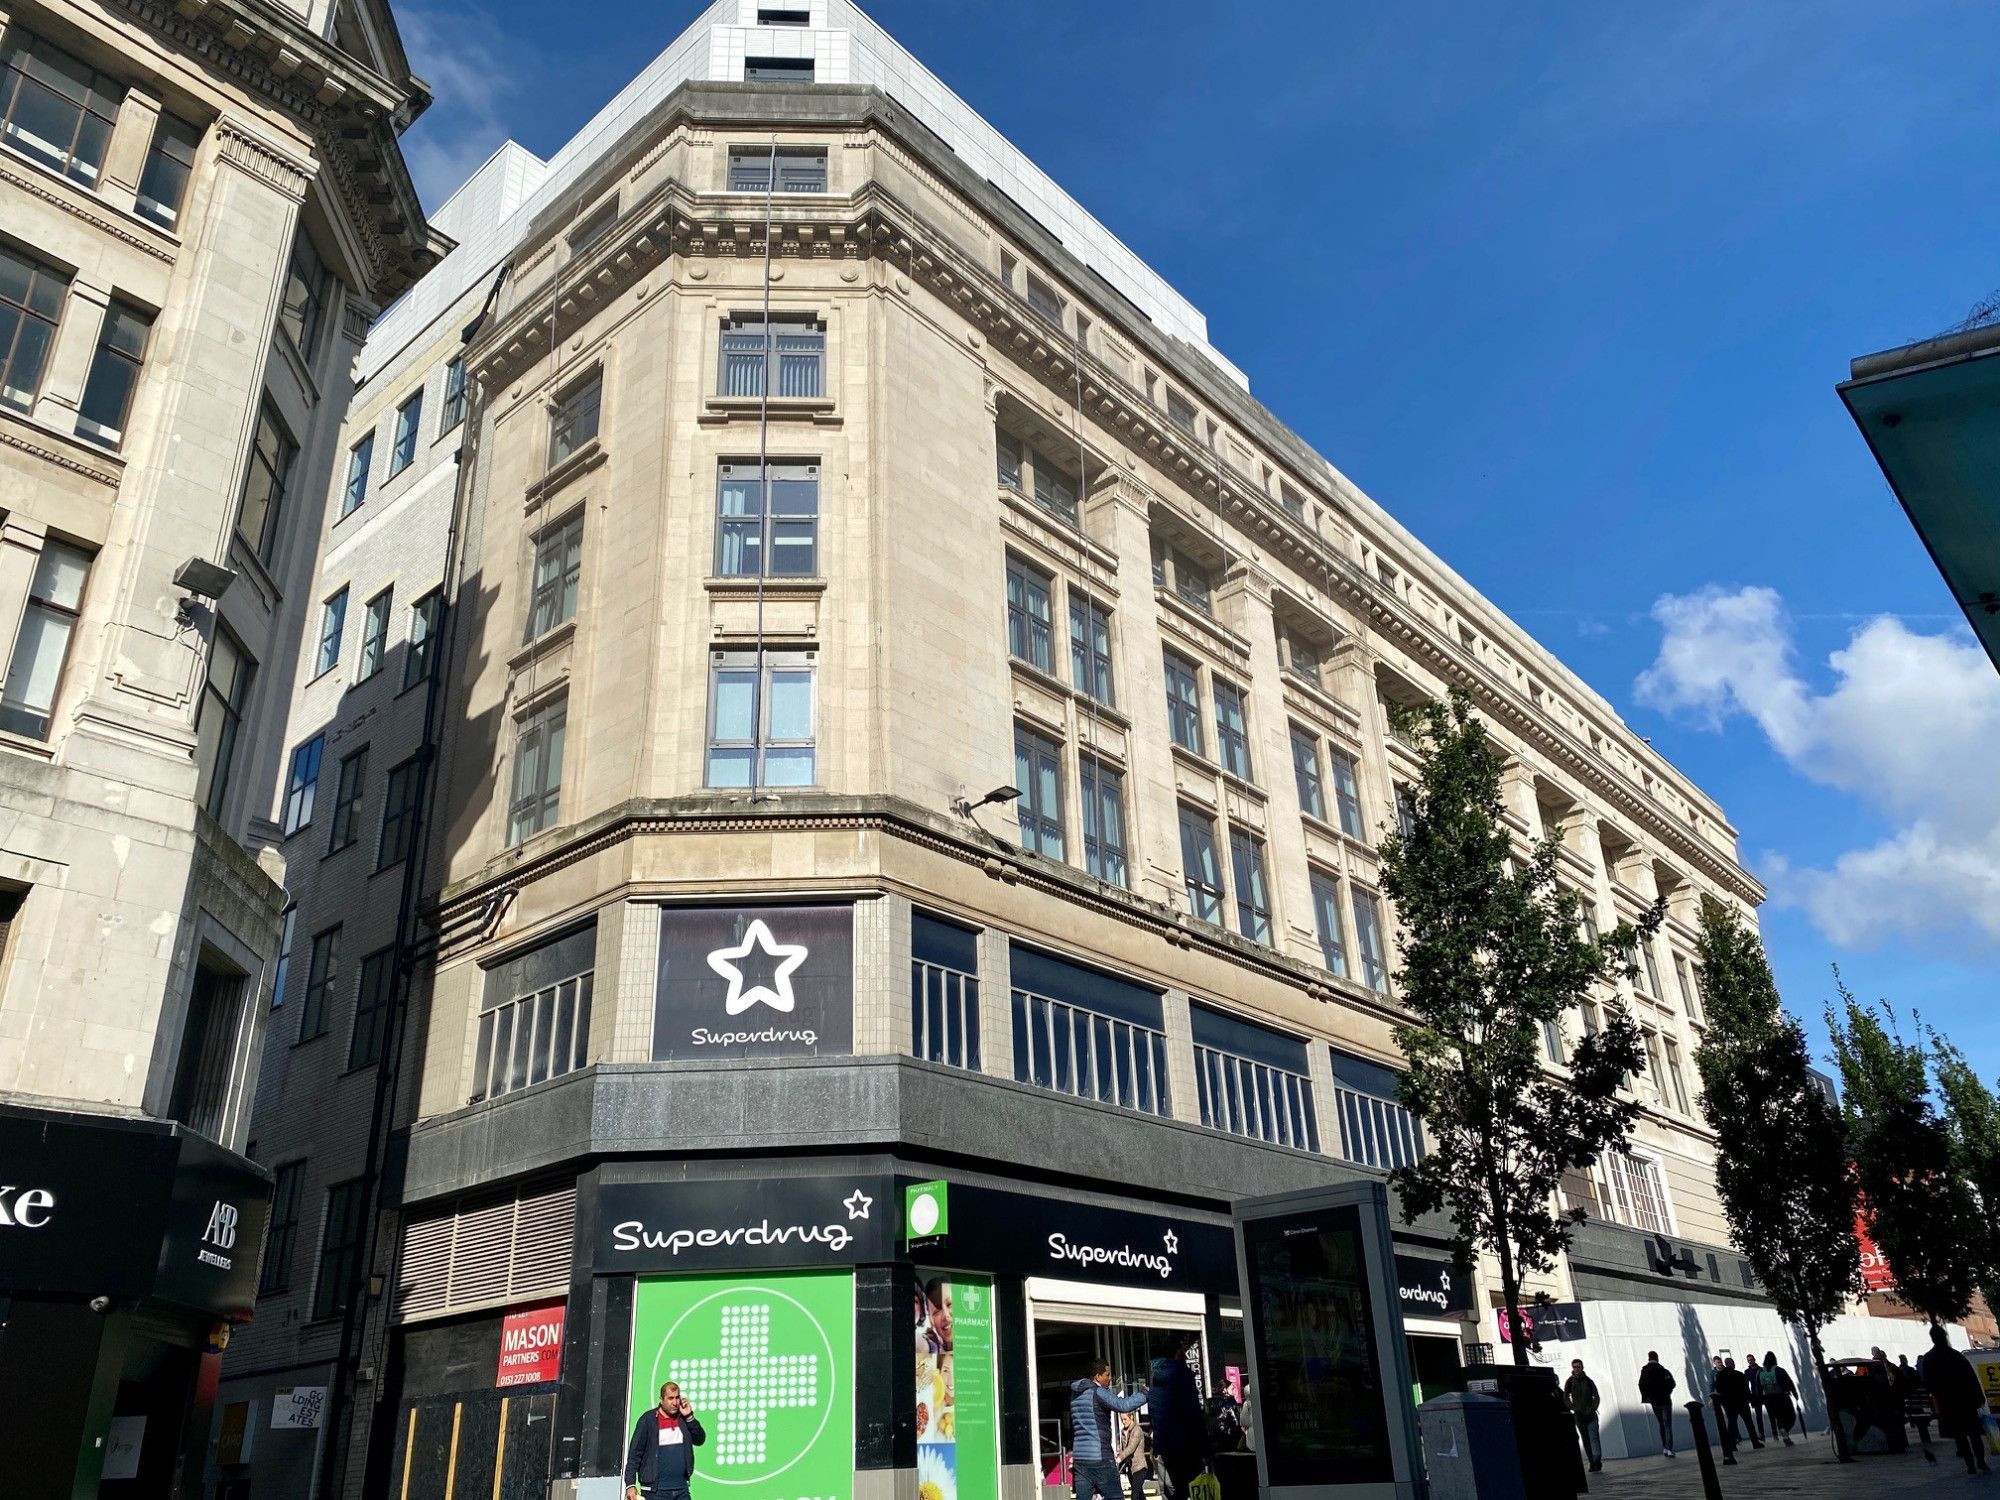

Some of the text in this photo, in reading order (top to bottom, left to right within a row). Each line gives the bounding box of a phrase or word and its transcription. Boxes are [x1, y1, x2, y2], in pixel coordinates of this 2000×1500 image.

[691, 1026, 818, 1046] Superdrug
[612, 1219, 854, 1256] Superdrug
[1048, 1232, 1172, 1279] Superdrug
[954, 1317, 989, 1327] PHARMACY
[504, 1322, 560, 1352] MASON
[291, 1394, 321, 1410] LDING
[288, 1413, 314, 1427] ATES
[300, 1406, 320, 1418] EST
